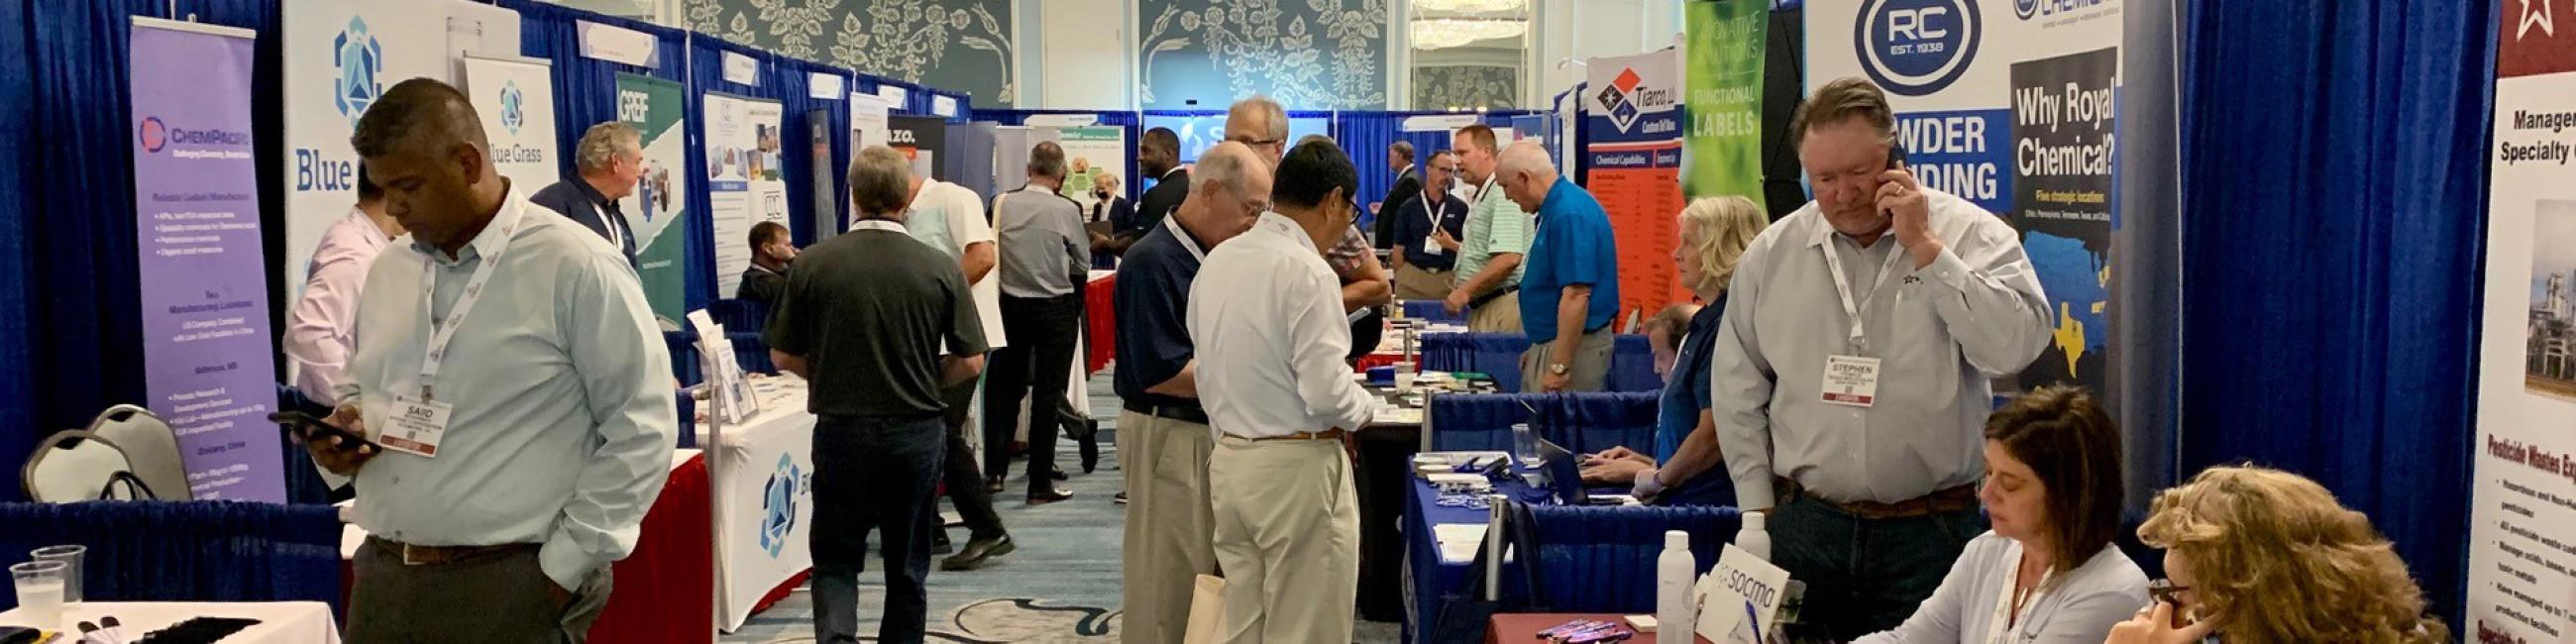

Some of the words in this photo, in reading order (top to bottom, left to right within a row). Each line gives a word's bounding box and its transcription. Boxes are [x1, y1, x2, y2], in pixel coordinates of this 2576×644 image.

[1888, 7, 1947, 42] RC
[1890, 45, 1913, 55] EST.
[1694, 85, 1755, 105] FUNCTIONAL
[2016, 88, 2061, 133] Why
[2066, 76, 2114, 130] Royal
[1693, 110, 1754, 137] LABELS
[2514, 110, 2576, 133] Manage
[512, 144, 542, 163] Grass
[2017, 133, 2114, 177] Chemical?
[2501, 140, 2570, 166] Specialty
[295, 149, 352, 191] Blue
[2487, 433, 2526, 465] Pesticide
[2528, 444, 2560, 474] Wastes
[1728, 569, 1775, 608] socma
